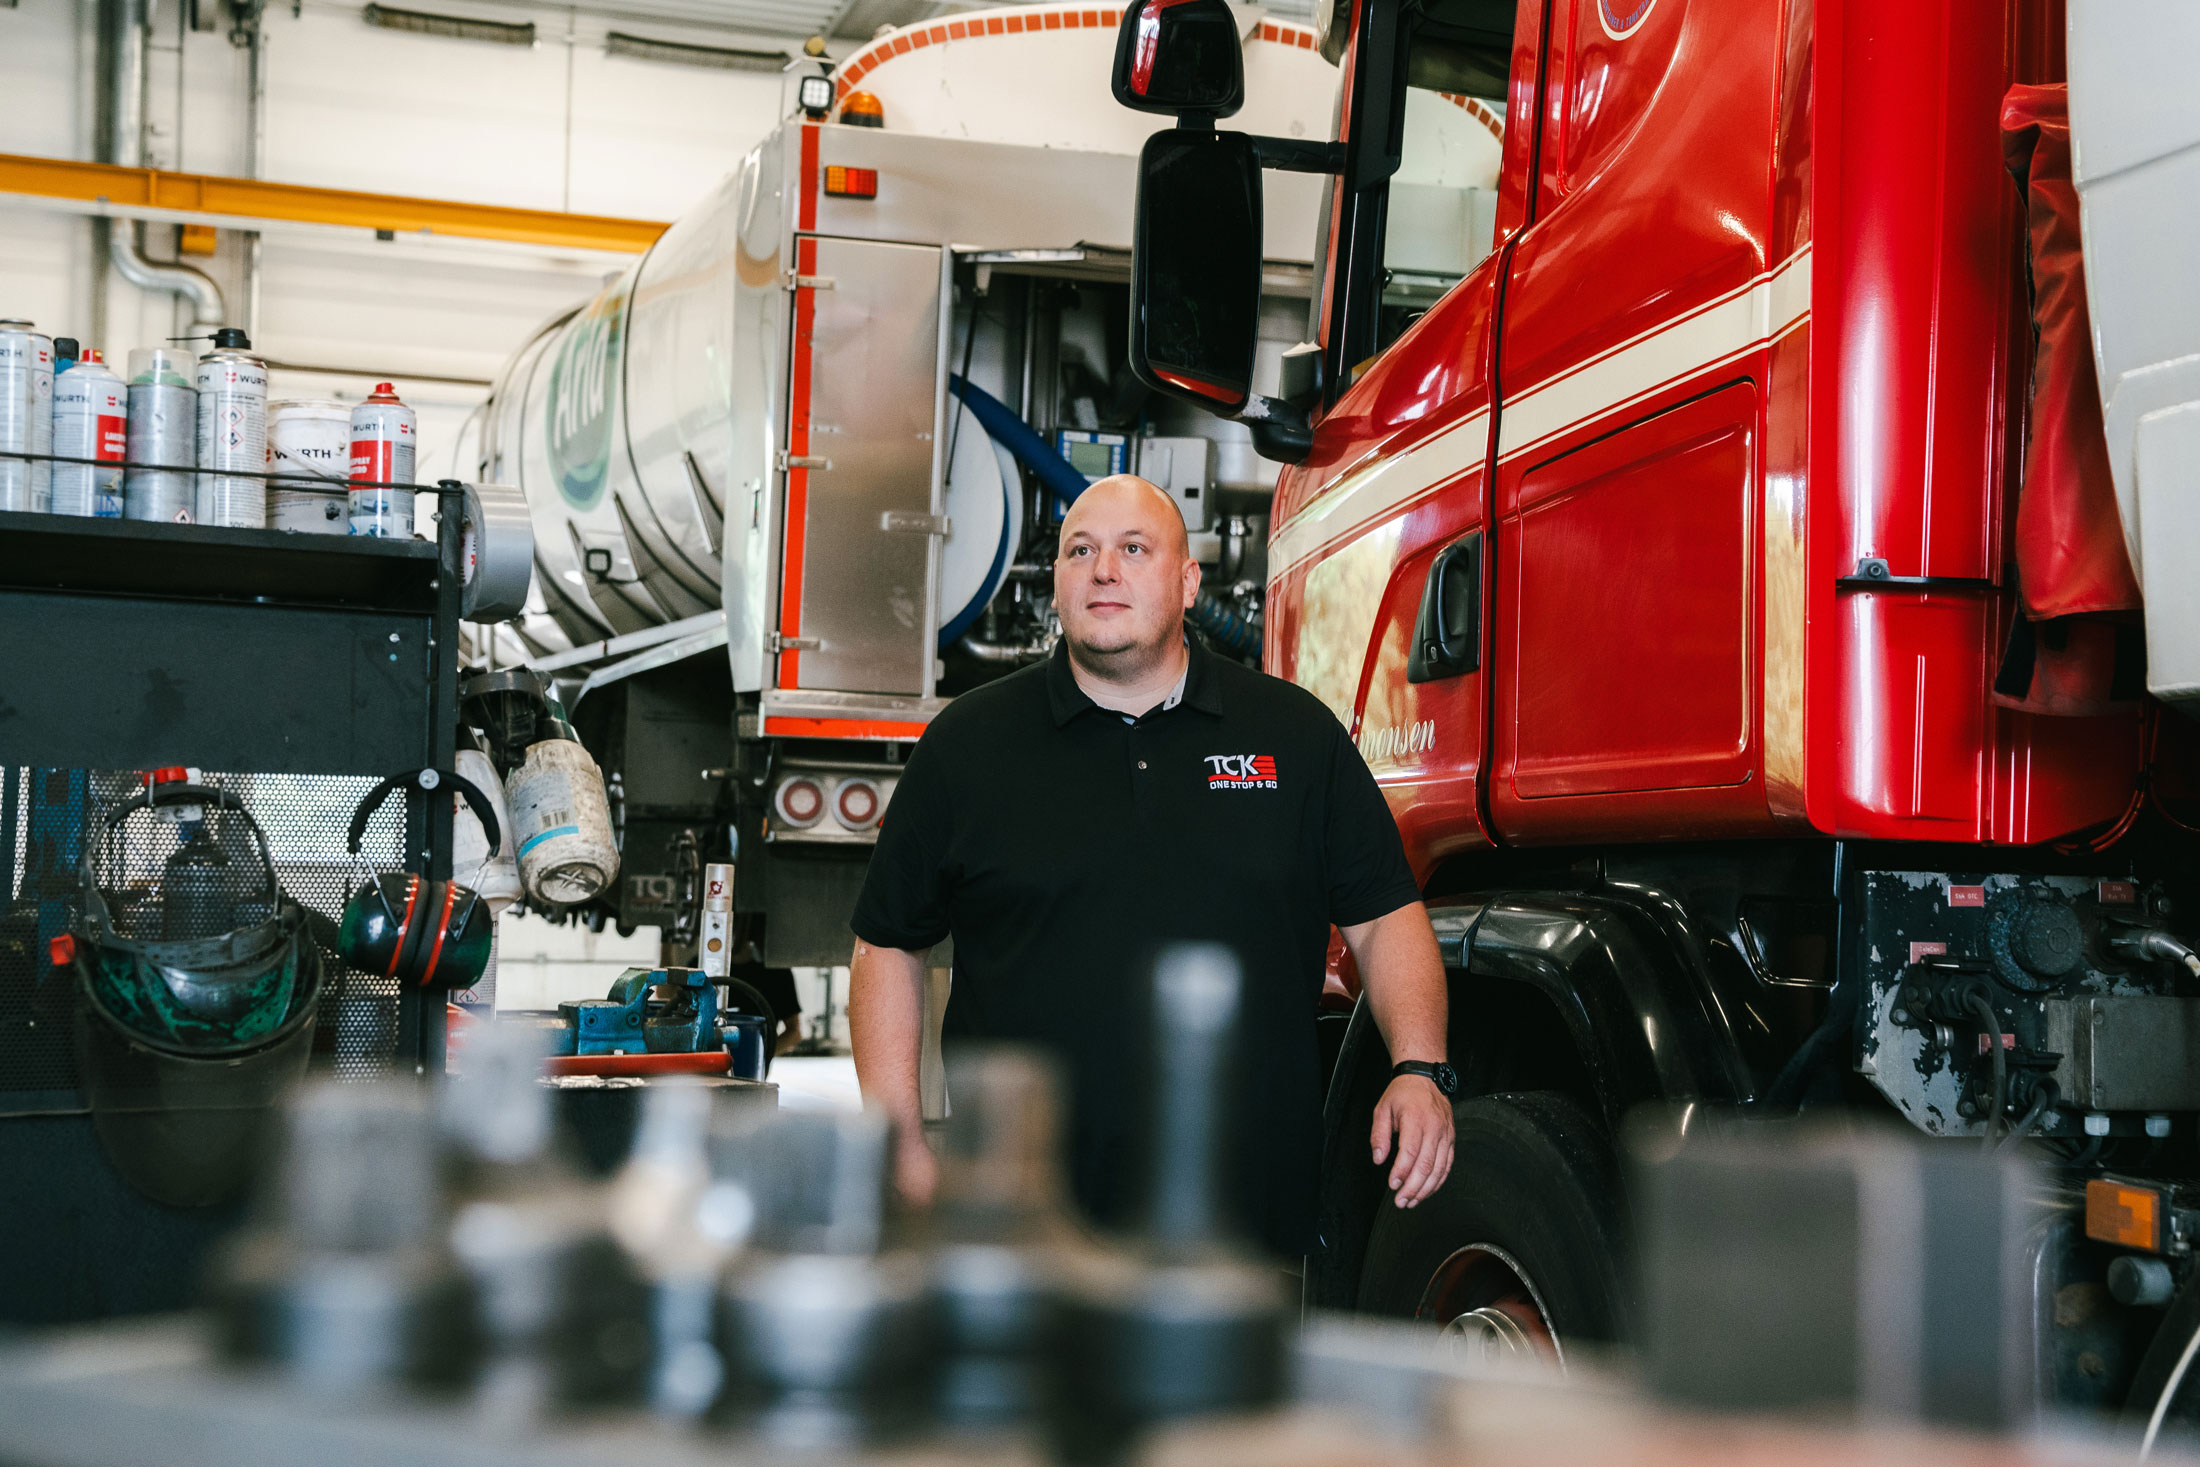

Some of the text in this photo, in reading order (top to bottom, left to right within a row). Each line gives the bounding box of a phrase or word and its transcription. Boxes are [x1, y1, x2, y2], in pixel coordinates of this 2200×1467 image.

[554, 318, 610, 449] Arla
[274, 447, 331, 460] WRTH
[1203, 754, 1260, 782] TCK
[1209, 780, 1278, 791] ONE STOP & GO
